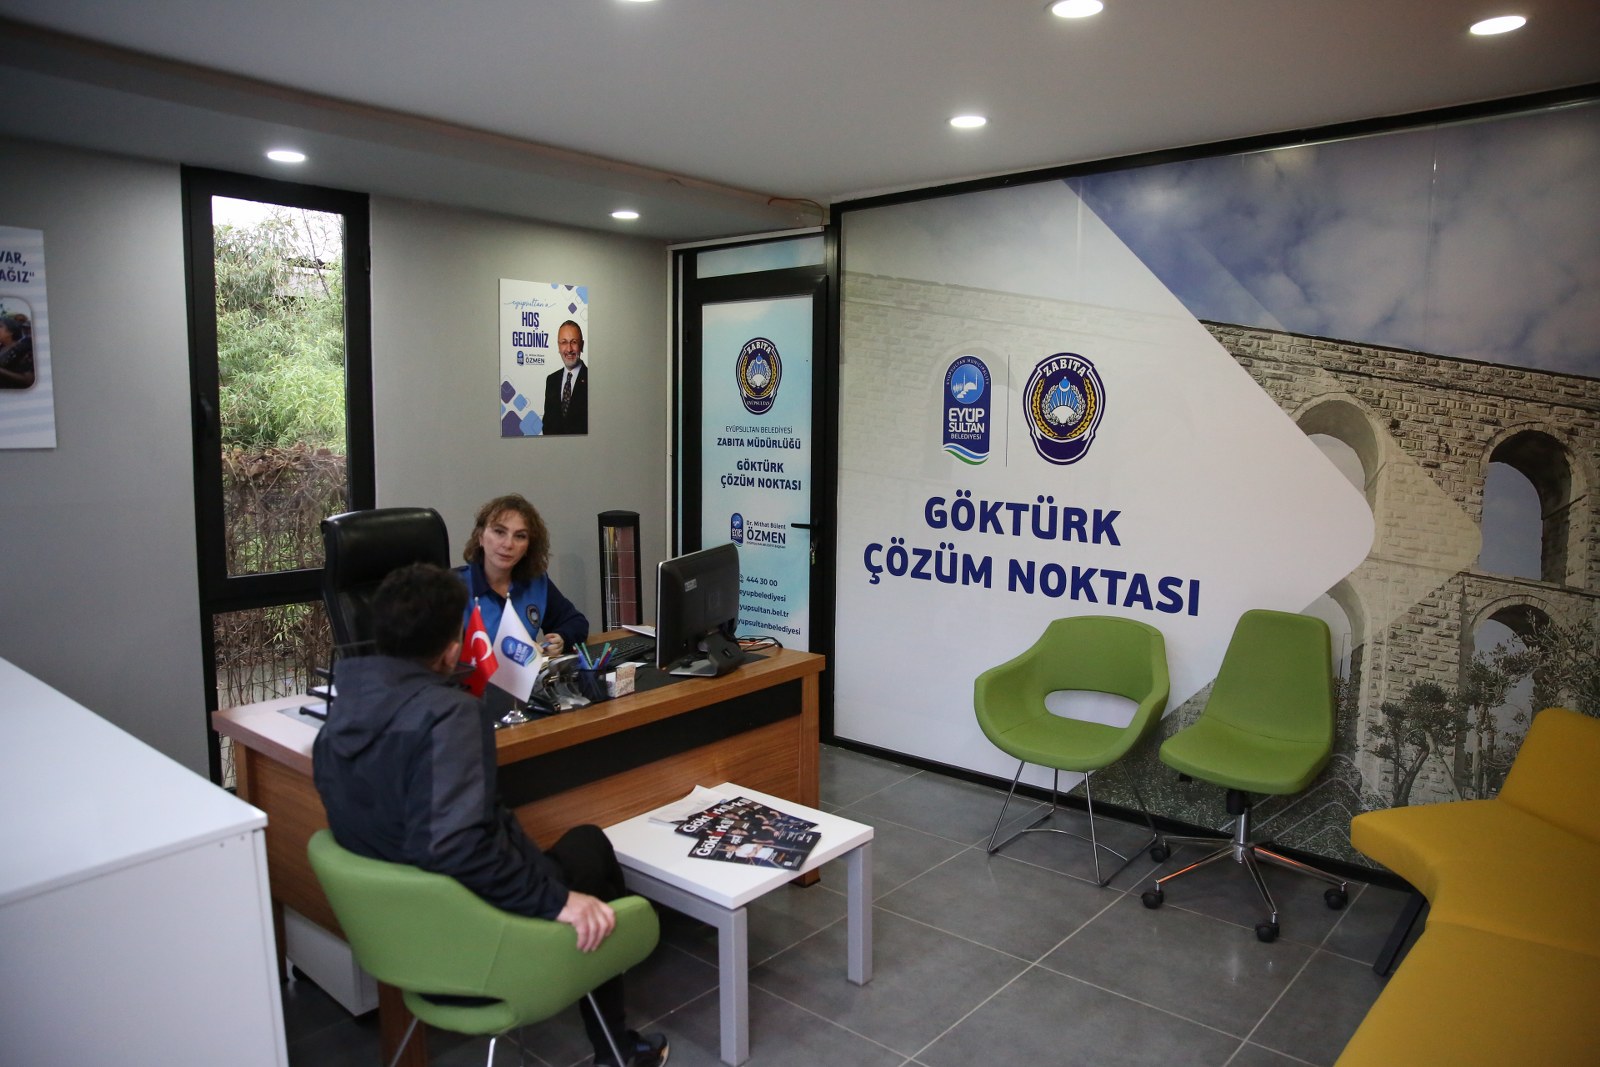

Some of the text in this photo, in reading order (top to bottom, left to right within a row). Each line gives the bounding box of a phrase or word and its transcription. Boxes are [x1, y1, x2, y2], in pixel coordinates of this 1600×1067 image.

[521, 311, 540, 330] HOŞ
[512, 330, 549, 348] GELDİNİZ
[746, 341, 772, 355] ZABITA
[1043, 359, 1087, 377] ZABITA
[948, 407, 985, 423] EYÜP
[725, 424, 793, 434] EYÜPSULTAN BELEDİYESİ
[948, 422, 985, 434] SULTAN
[717, 436, 801, 450] ZABITA MÜDÜRLÜĞÜ
[736, 458, 784, 473] GÖKTÜRK
[720, 473, 801, 491] ÇÖZÜM NOKTASI
[924, 489, 1122, 546] GÖKTÜRK
[746, 526, 786, 545] ÖZMEN
[746, 576, 778, 587] 444 30 00
[863, 536, 1200, 617] ÇÖZÜM NOKTASI
[739, 604, 789, 618] yupsultan.bel.tr
[737, 618, 801, 635] yupsultanbelediyesi
